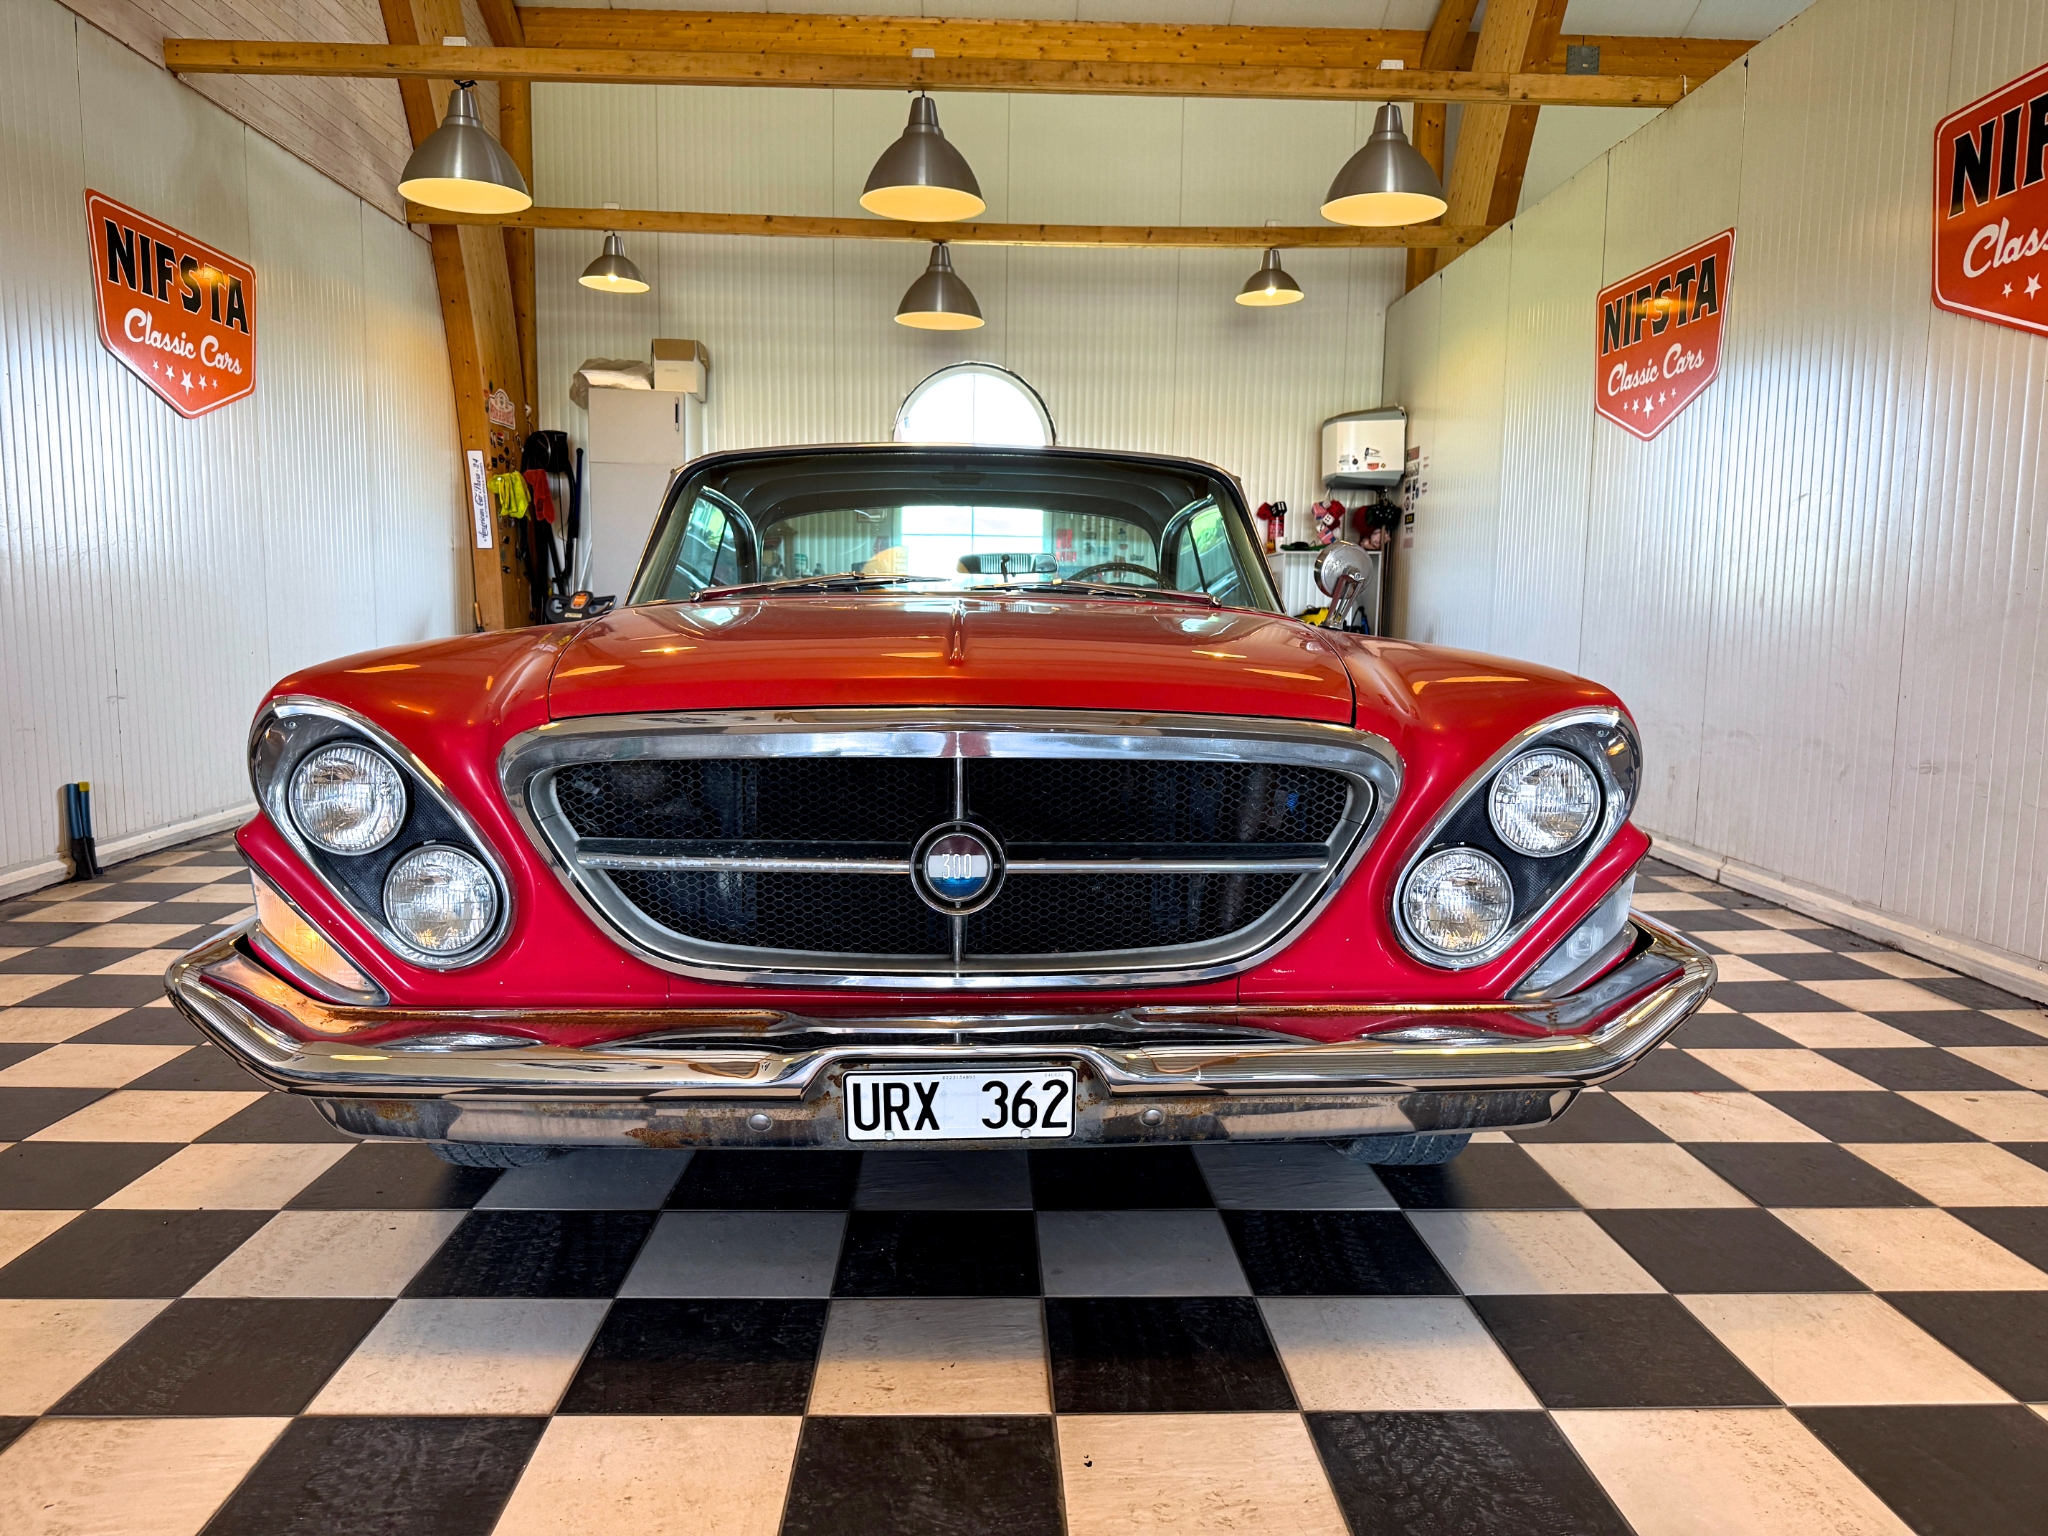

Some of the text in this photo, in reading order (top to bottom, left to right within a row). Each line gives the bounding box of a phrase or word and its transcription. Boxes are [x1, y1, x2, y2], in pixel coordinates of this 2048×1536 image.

[103, 217, 250, 336] NIFSTA
[1601, 253, 1719, 357] NIFSTA
[124, 308, 242, 375] Classic Cars
[1608, 343, 1705, 396] Classic Cars
[474, 494, 484, 507] Car
[478, 508, 488, 542] American
[942, 853, 972, 879] 300
[853, 1079, 1069, 1131] URX 362
